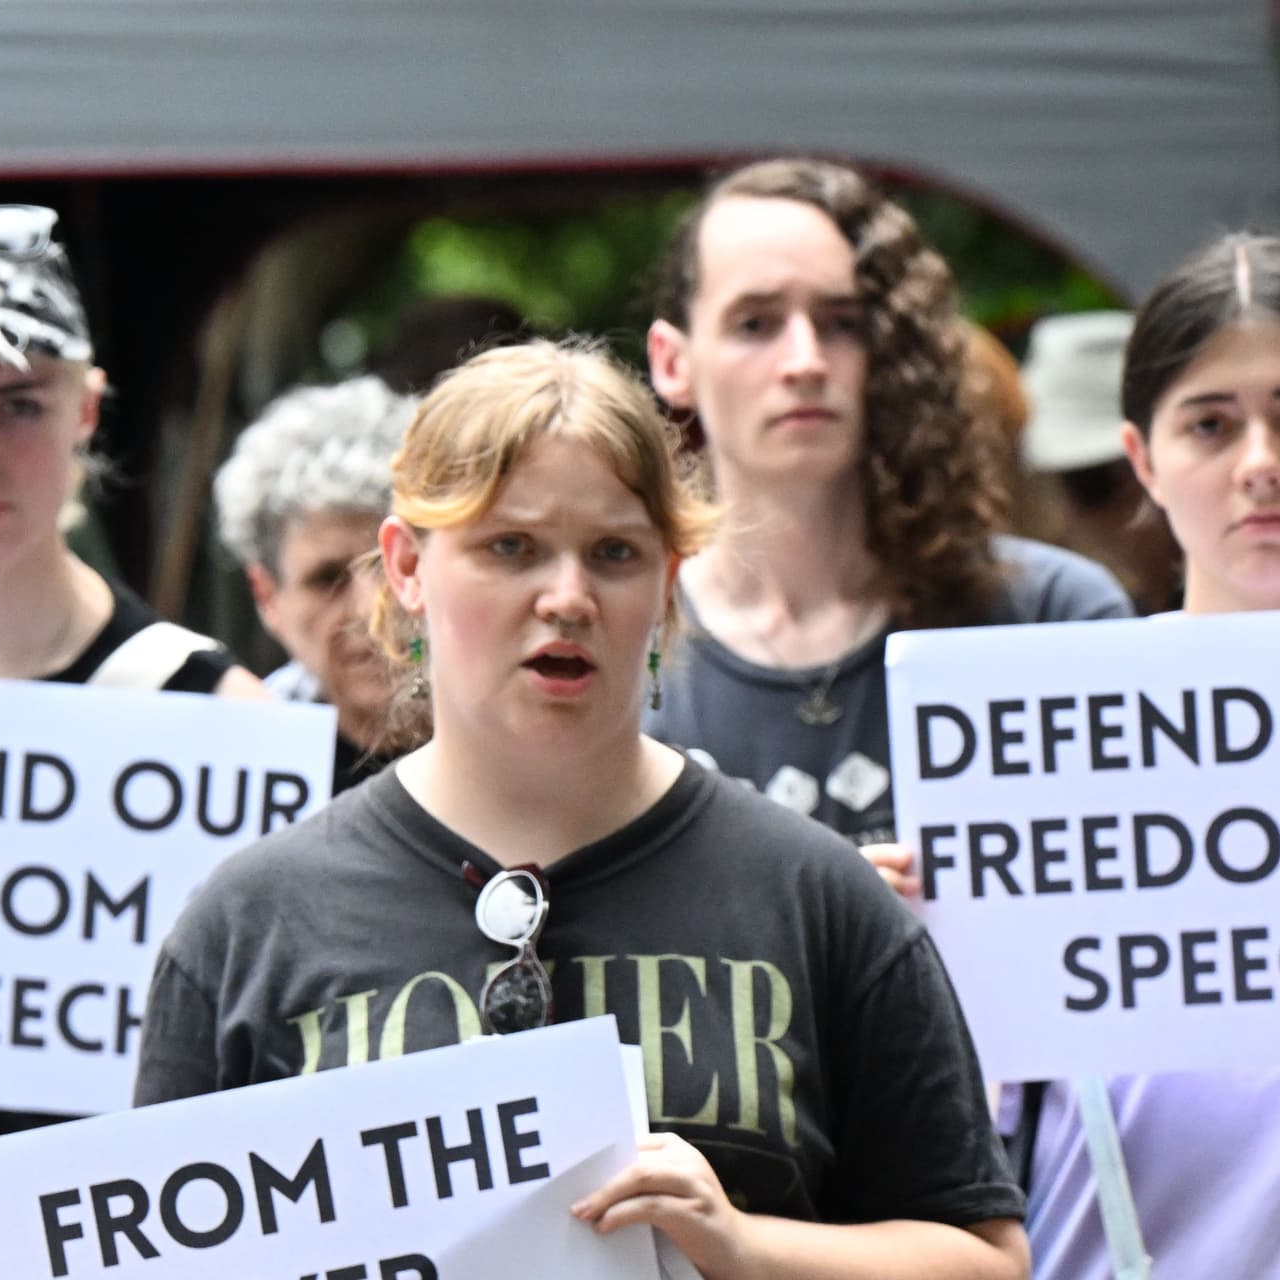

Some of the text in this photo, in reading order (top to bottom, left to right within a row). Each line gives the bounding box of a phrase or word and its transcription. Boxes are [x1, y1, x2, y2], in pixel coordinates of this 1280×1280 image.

[916, 686, 1274, 780] DEFEND
[113, 760, 311, 836] OUR
[38, 1097, 551, 1278] FROM THE
